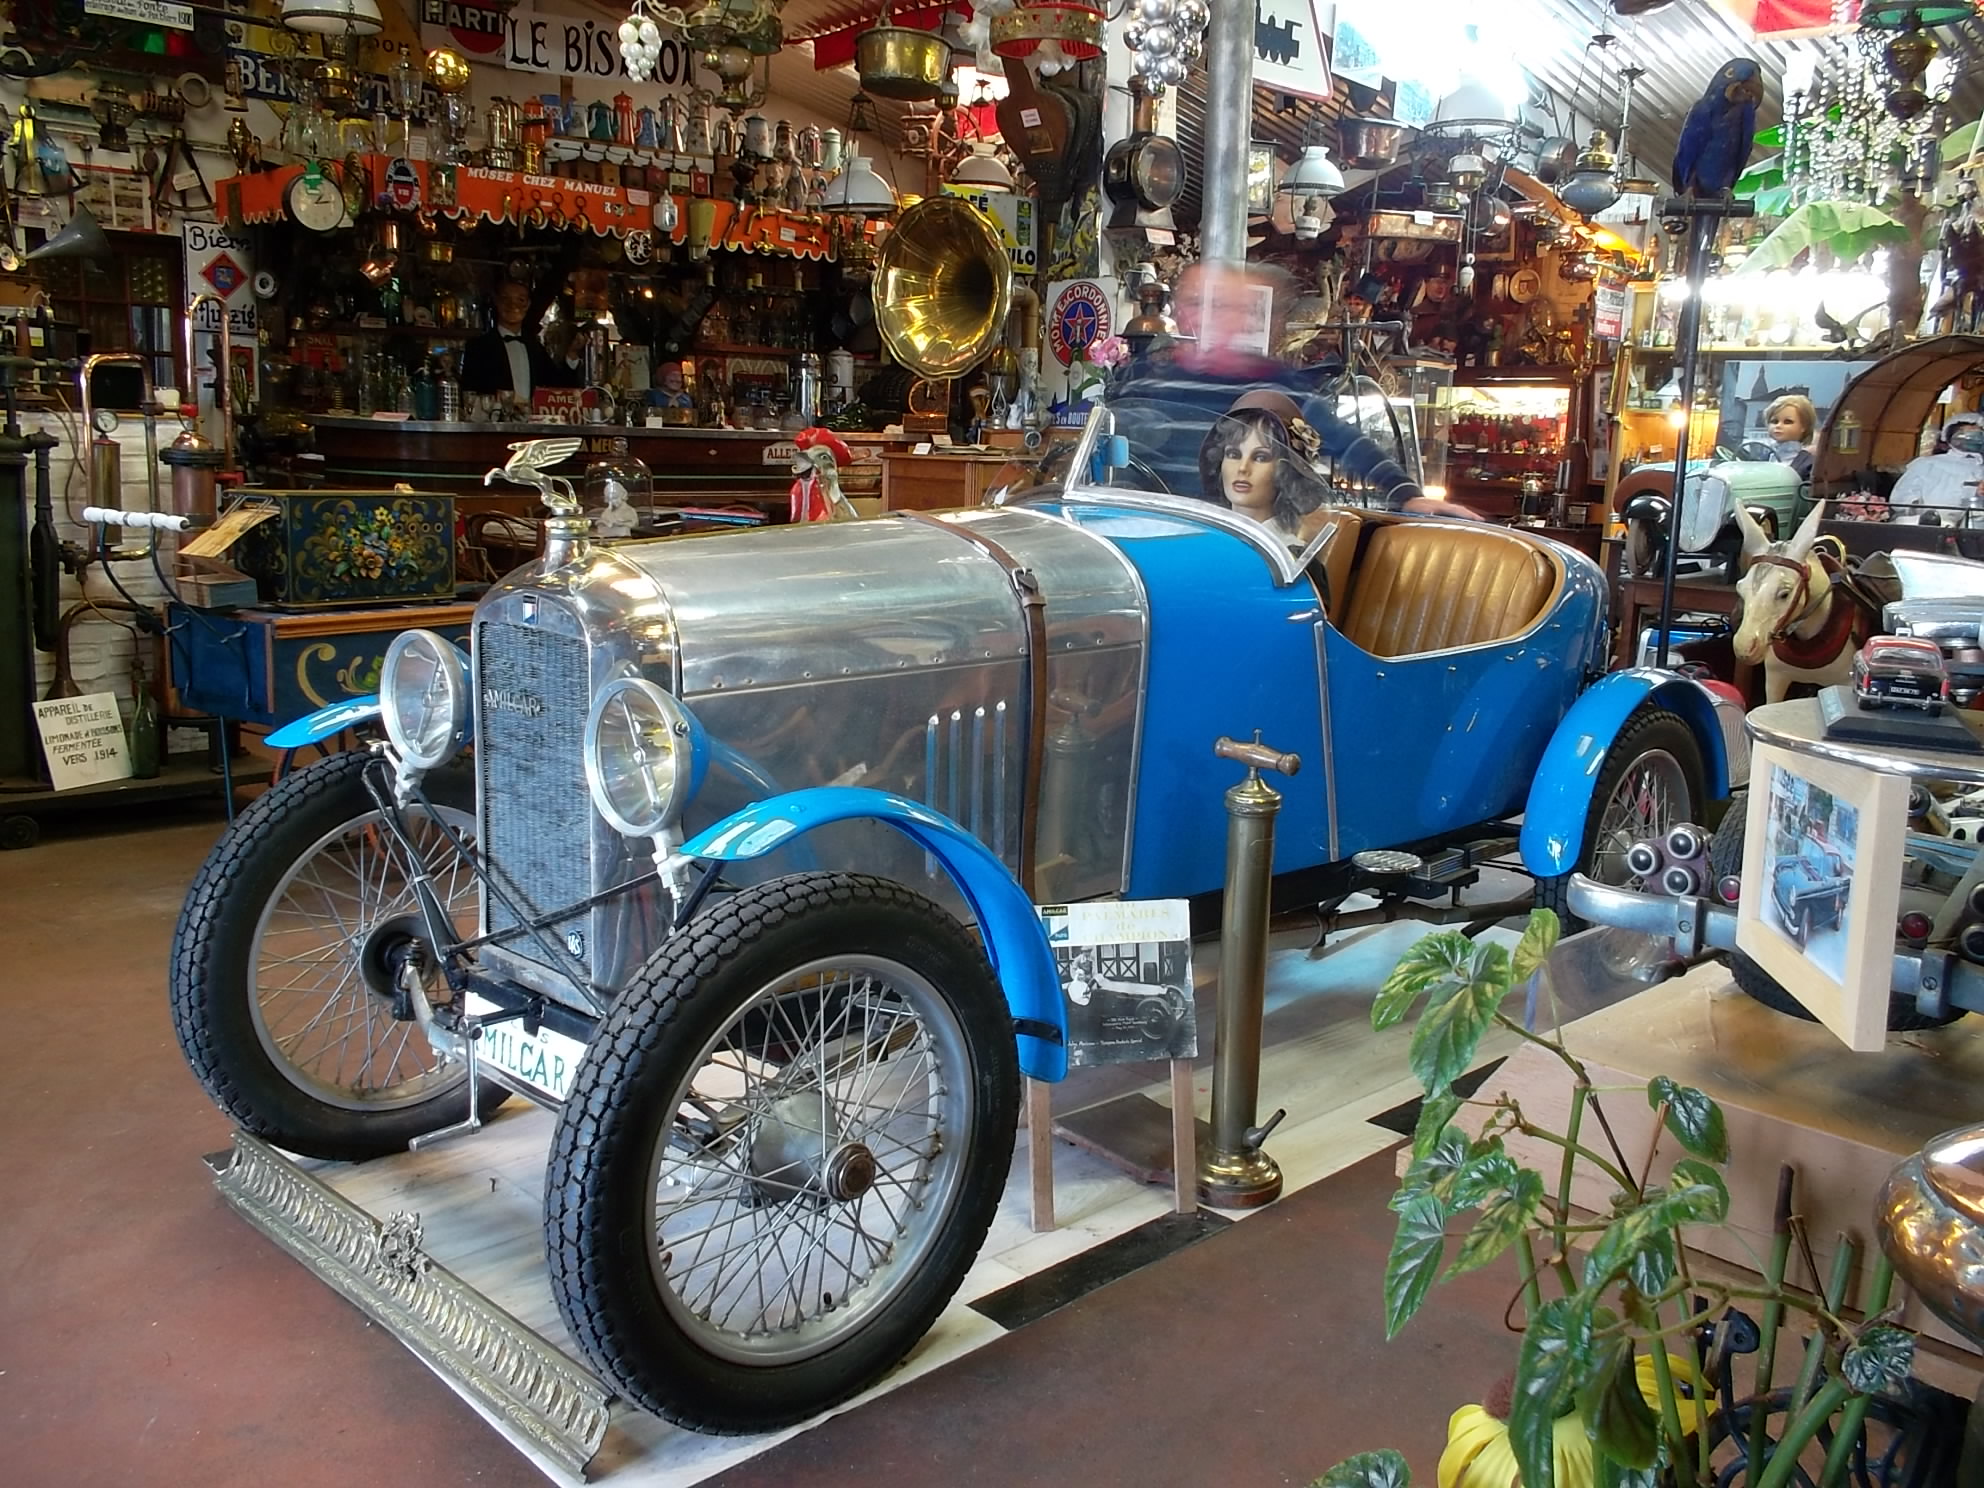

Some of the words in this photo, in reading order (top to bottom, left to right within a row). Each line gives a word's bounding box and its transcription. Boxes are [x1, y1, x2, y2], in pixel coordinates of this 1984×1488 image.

[507, 17, 549, 68] LE
[564, 20, 694, 87] BISOT
[523, 175, 555, 188] CHEZ
[564, 181, 617, 197] MANUEL
[1066, 286, 1108, 342] CORDONNIE
[38, 703, 81, 719] APPAREIL
[82, 703, 93, 712] DE
[65, 710, 113, 725] DISTILLERIE
[44, 731, 84, 745] LIMONADE
[62, 752, 87, 766] VERS
[95, 747, 119, 760] 1914
[475, 1027, 567, 1097] MILCAR
